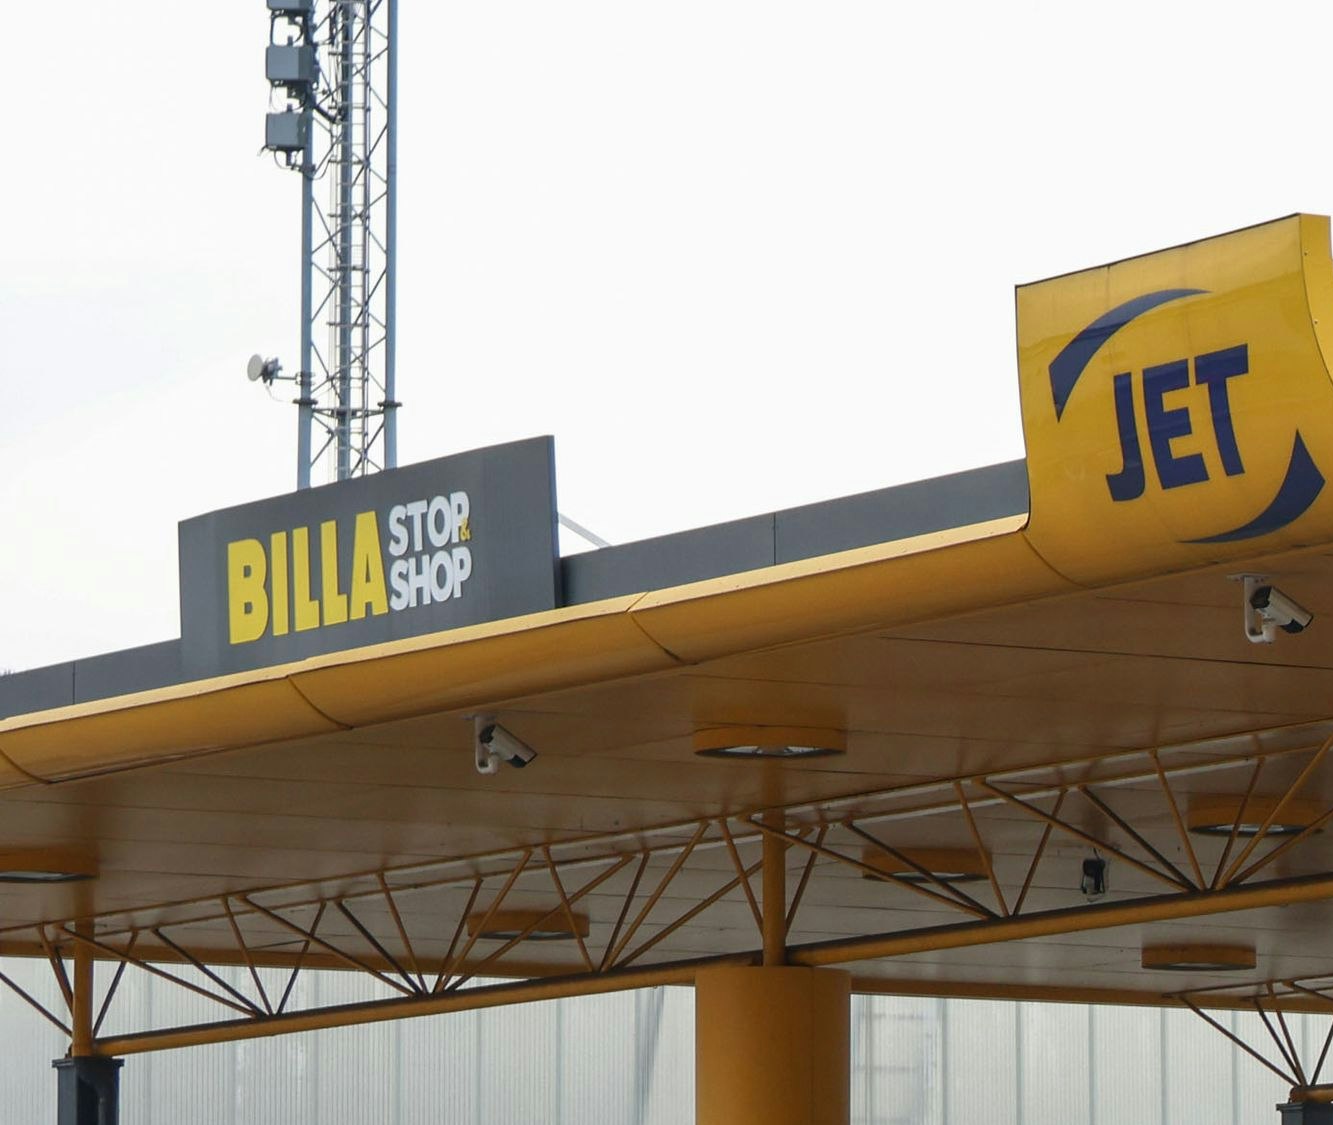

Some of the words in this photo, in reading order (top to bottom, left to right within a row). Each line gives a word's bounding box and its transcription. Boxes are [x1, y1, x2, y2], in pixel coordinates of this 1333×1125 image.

[1106, 343, 1249, 502] JET
[388, 491, 470, 557] STOP
[227, 510, 389, 645] BILLA
[390, 546, 472, 611] SHOP
